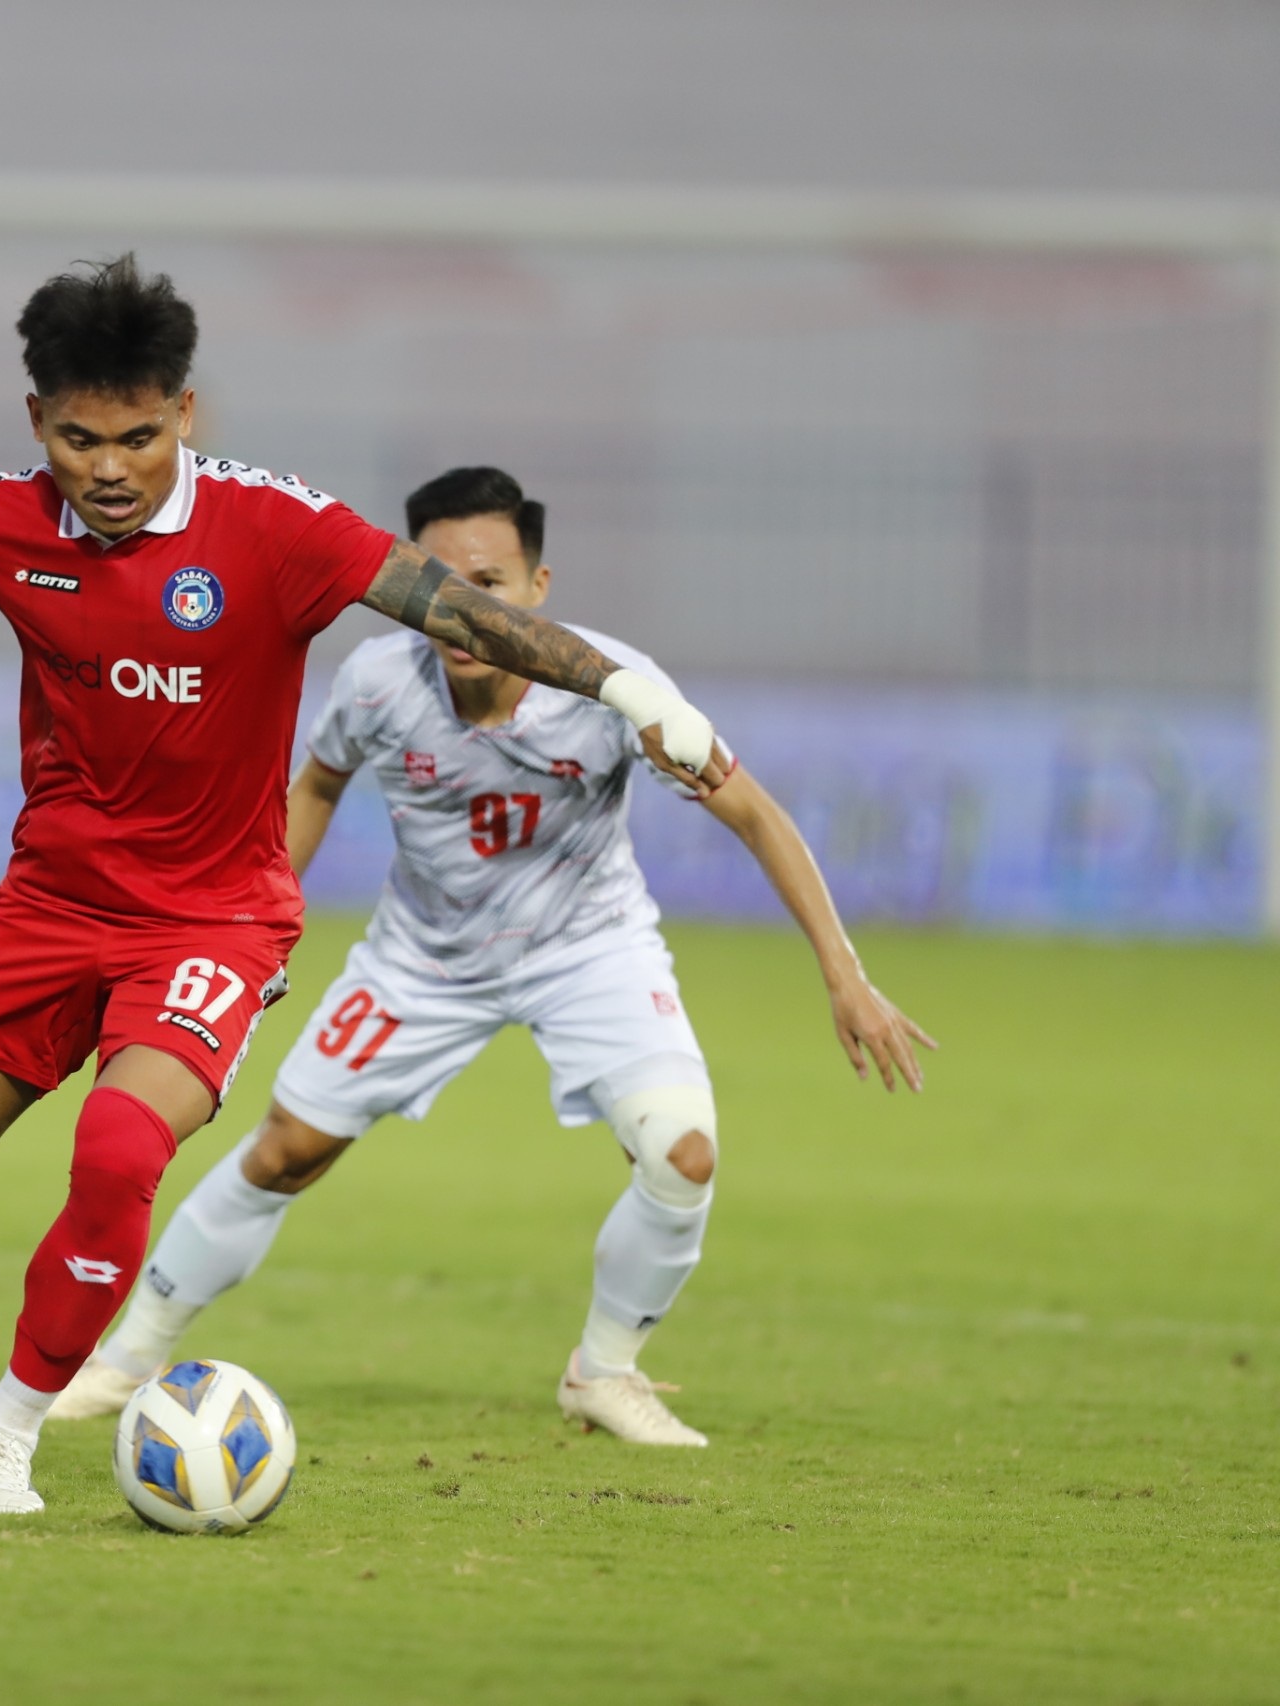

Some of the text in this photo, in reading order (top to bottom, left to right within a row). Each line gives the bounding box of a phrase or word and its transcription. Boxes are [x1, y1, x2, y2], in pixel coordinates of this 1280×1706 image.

[30, 573, 79, 590] LOTTO
[174, 571, 211, 585] SABAH
[469, 791, 542, 859] 97
[164, 957, 246, 1025] 67
[171, 1014, 221, 1048] LOTTO
[316, 987, 403, 1071] 97
